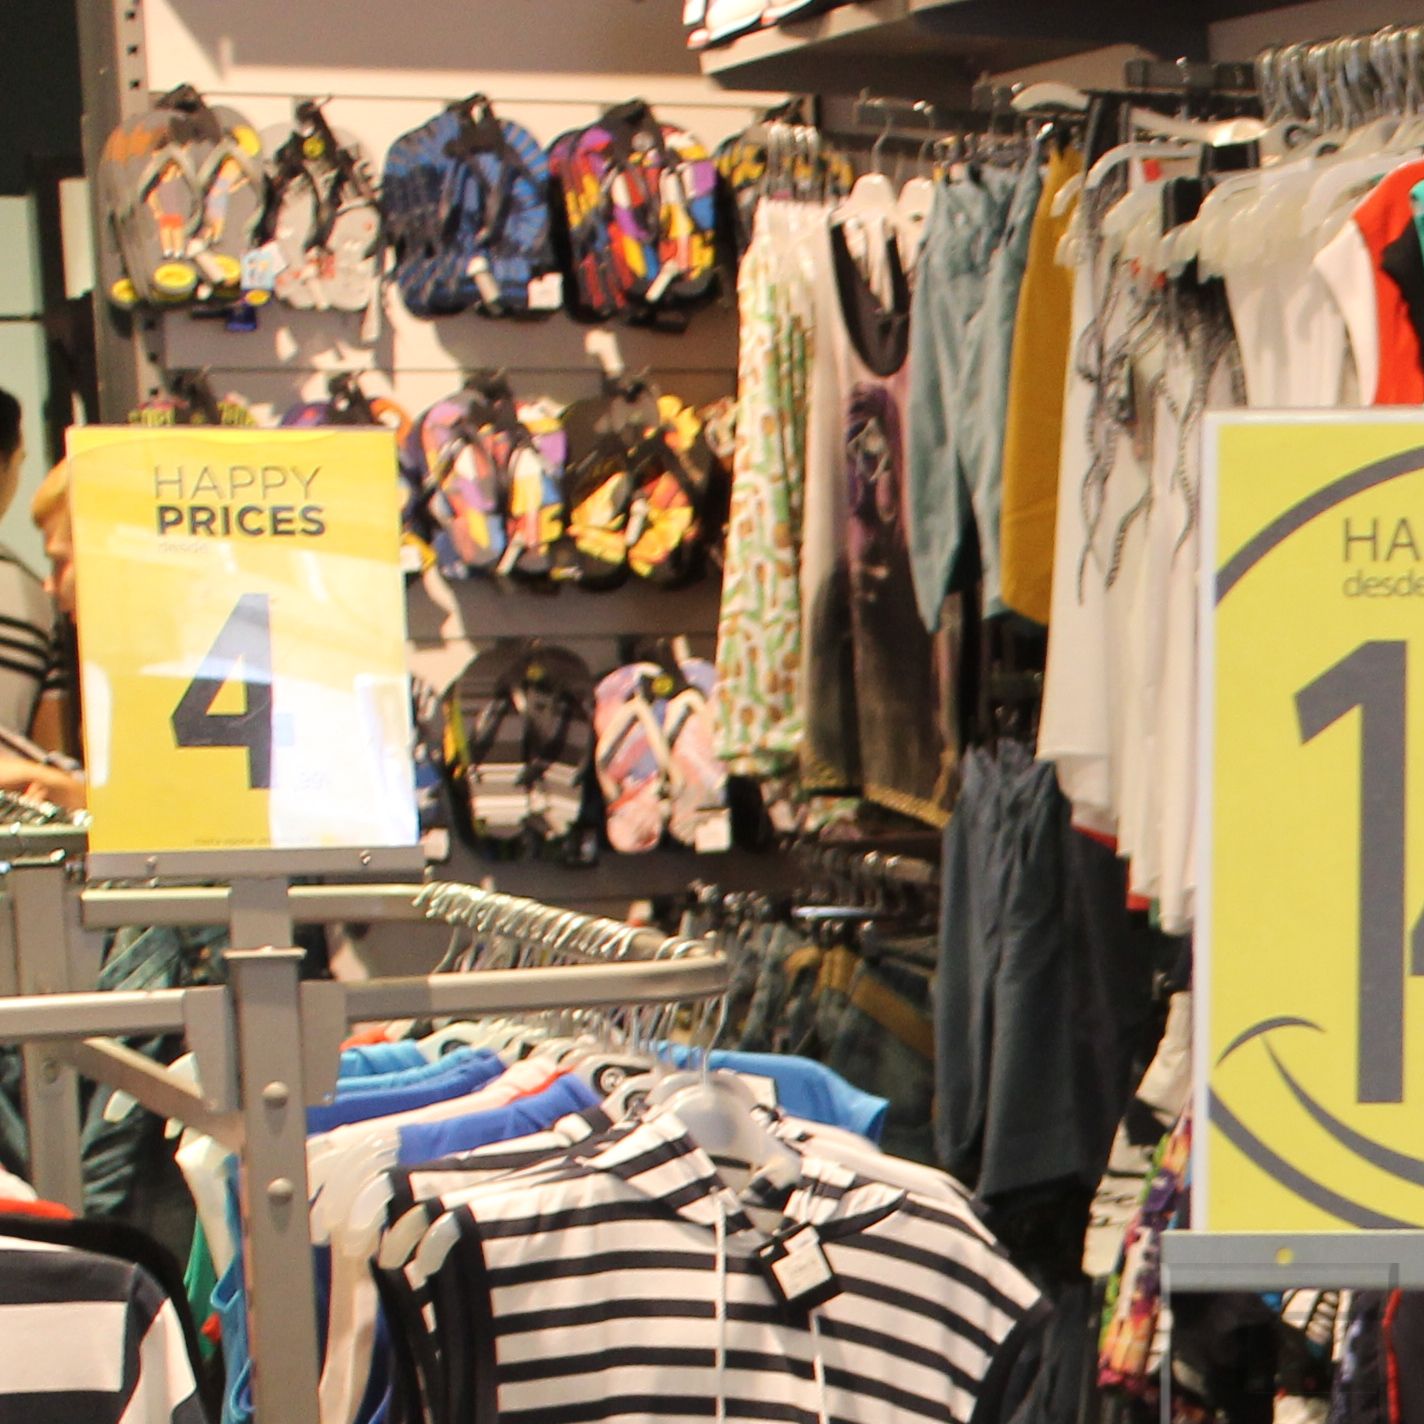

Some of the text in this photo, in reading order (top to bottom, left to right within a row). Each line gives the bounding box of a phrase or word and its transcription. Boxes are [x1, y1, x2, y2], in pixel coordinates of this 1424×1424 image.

[153, 465, 323, 500] HAPPY
[156, 504, 326, 537] PRICES
[170, 592, 272, 790] 4
